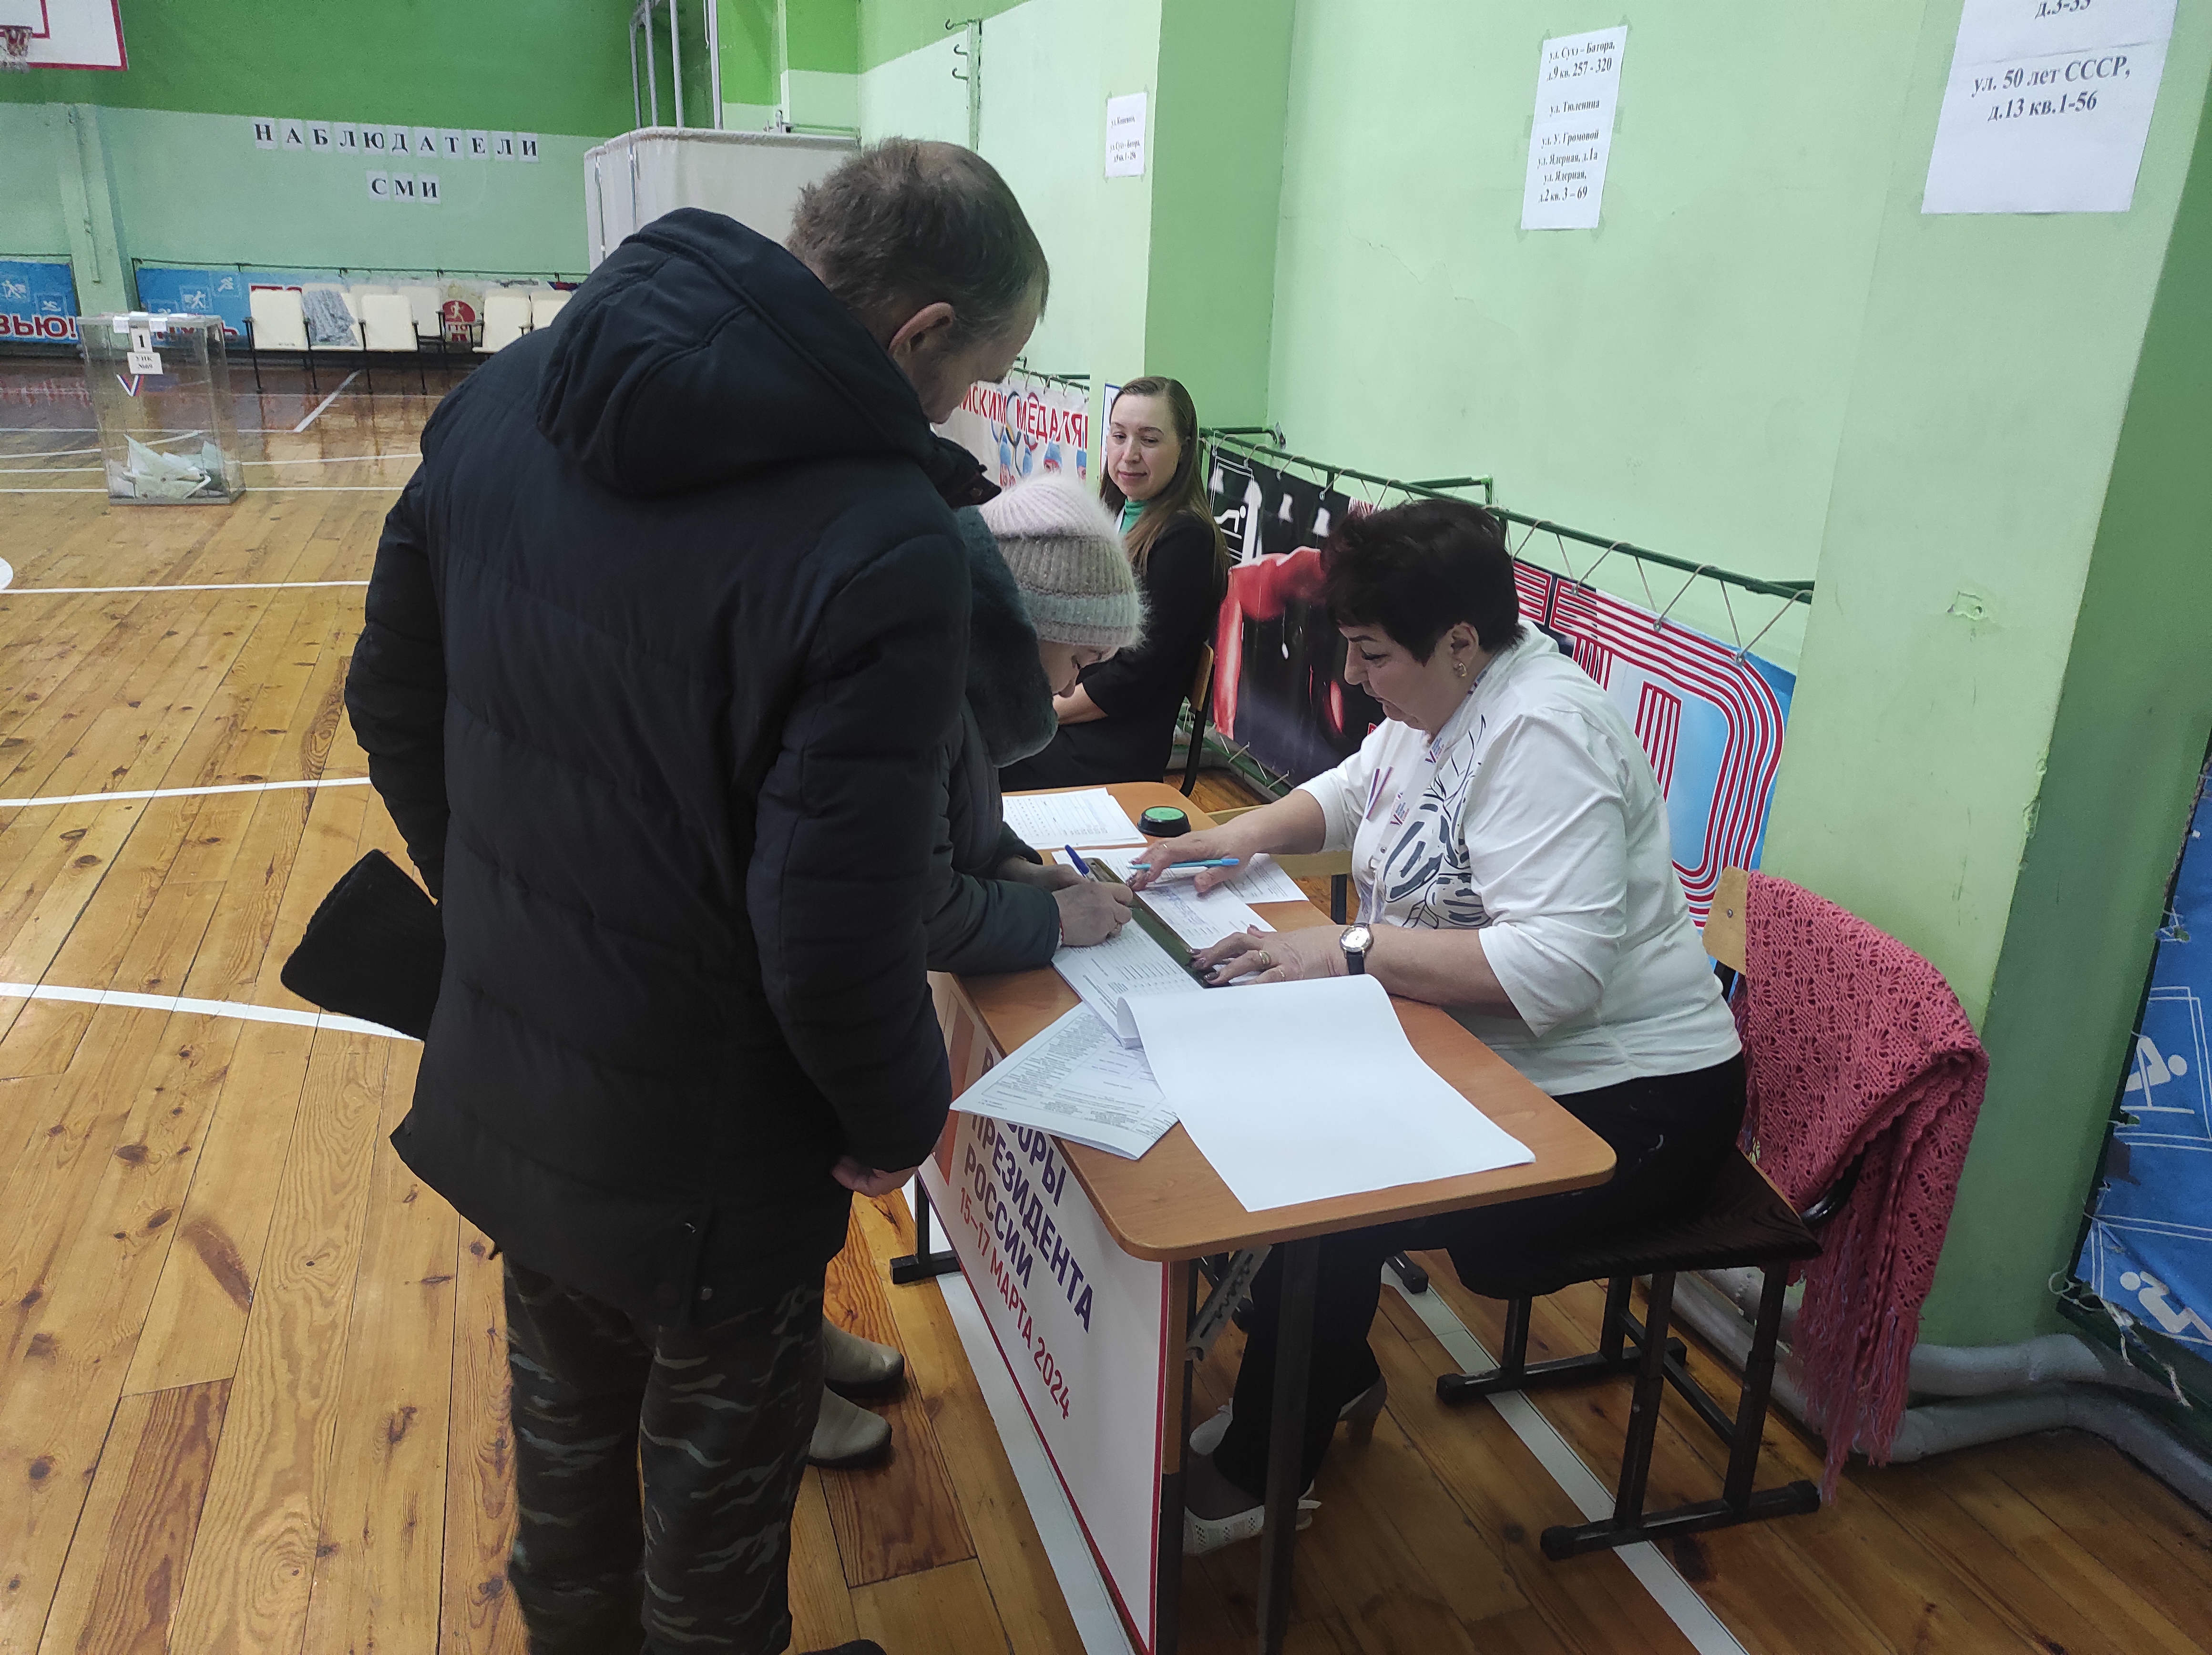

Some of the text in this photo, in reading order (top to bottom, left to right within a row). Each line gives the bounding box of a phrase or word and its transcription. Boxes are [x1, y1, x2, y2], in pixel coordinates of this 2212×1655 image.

[1573, 61, 1588, 77] 257
[1595, 57, 1612, 73] 320
[1971, 55, 2130, 98] ул. 50 лет СССР,
[1987, 97, 2025, 122] д.13
[256, 123, 538, 157] НАБЛЮДАТЕЛИ
[371, 178, 438, 198] СМИ
[1577, 184, 1587, 200] 69
[1017, 398, 1088, 450] МЕДАЛЯ
[964, 1143, 1034, 1290] РОССИИ
[989, 1246, 1033, 1350] МАРТА
[1033, 1336, 1071, 1420] 2024
